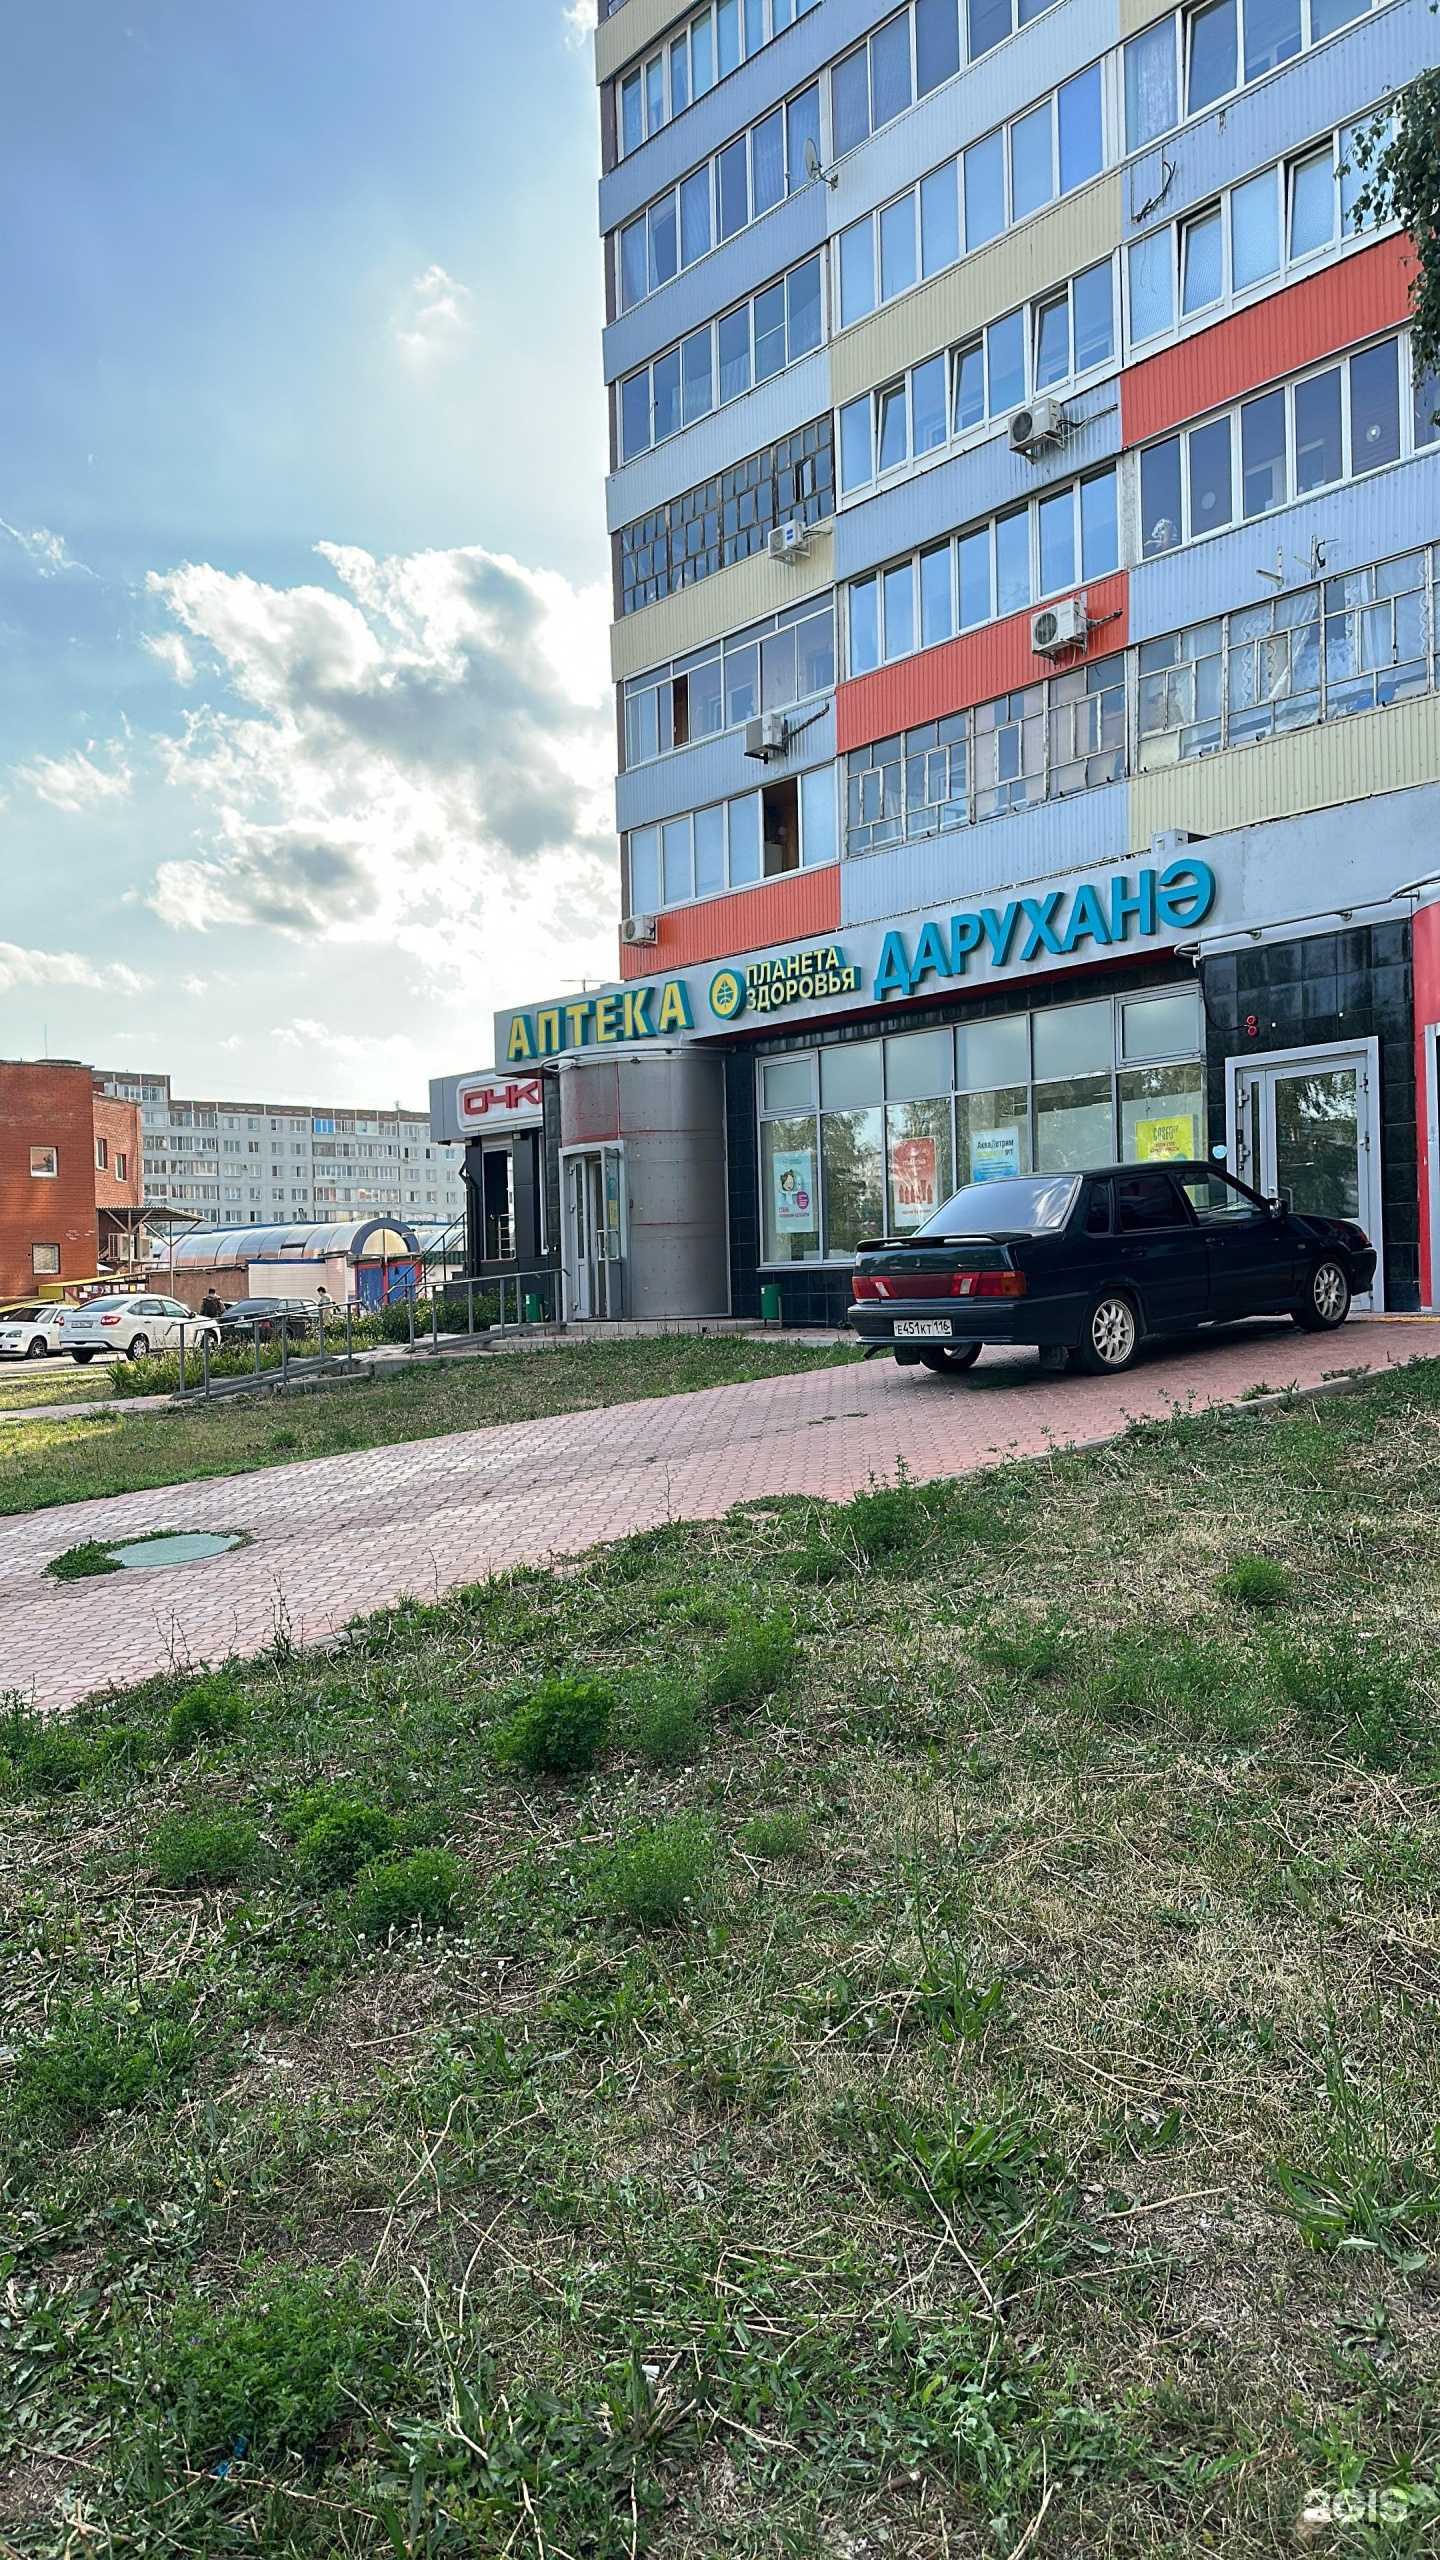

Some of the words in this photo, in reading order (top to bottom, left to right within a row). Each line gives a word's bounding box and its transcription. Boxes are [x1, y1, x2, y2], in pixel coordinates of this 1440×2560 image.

[874, 858, 1216, 1002] ДАРУХАНӘ
[746, 946, 845, 988] ПЛАНЕТА
[746, 966, 862, 1013] ЗДОРОВЬЯ
[507, 980, 695, 1061] АПТЕКА
[463, 1079, 543, 1116] ОЧК
